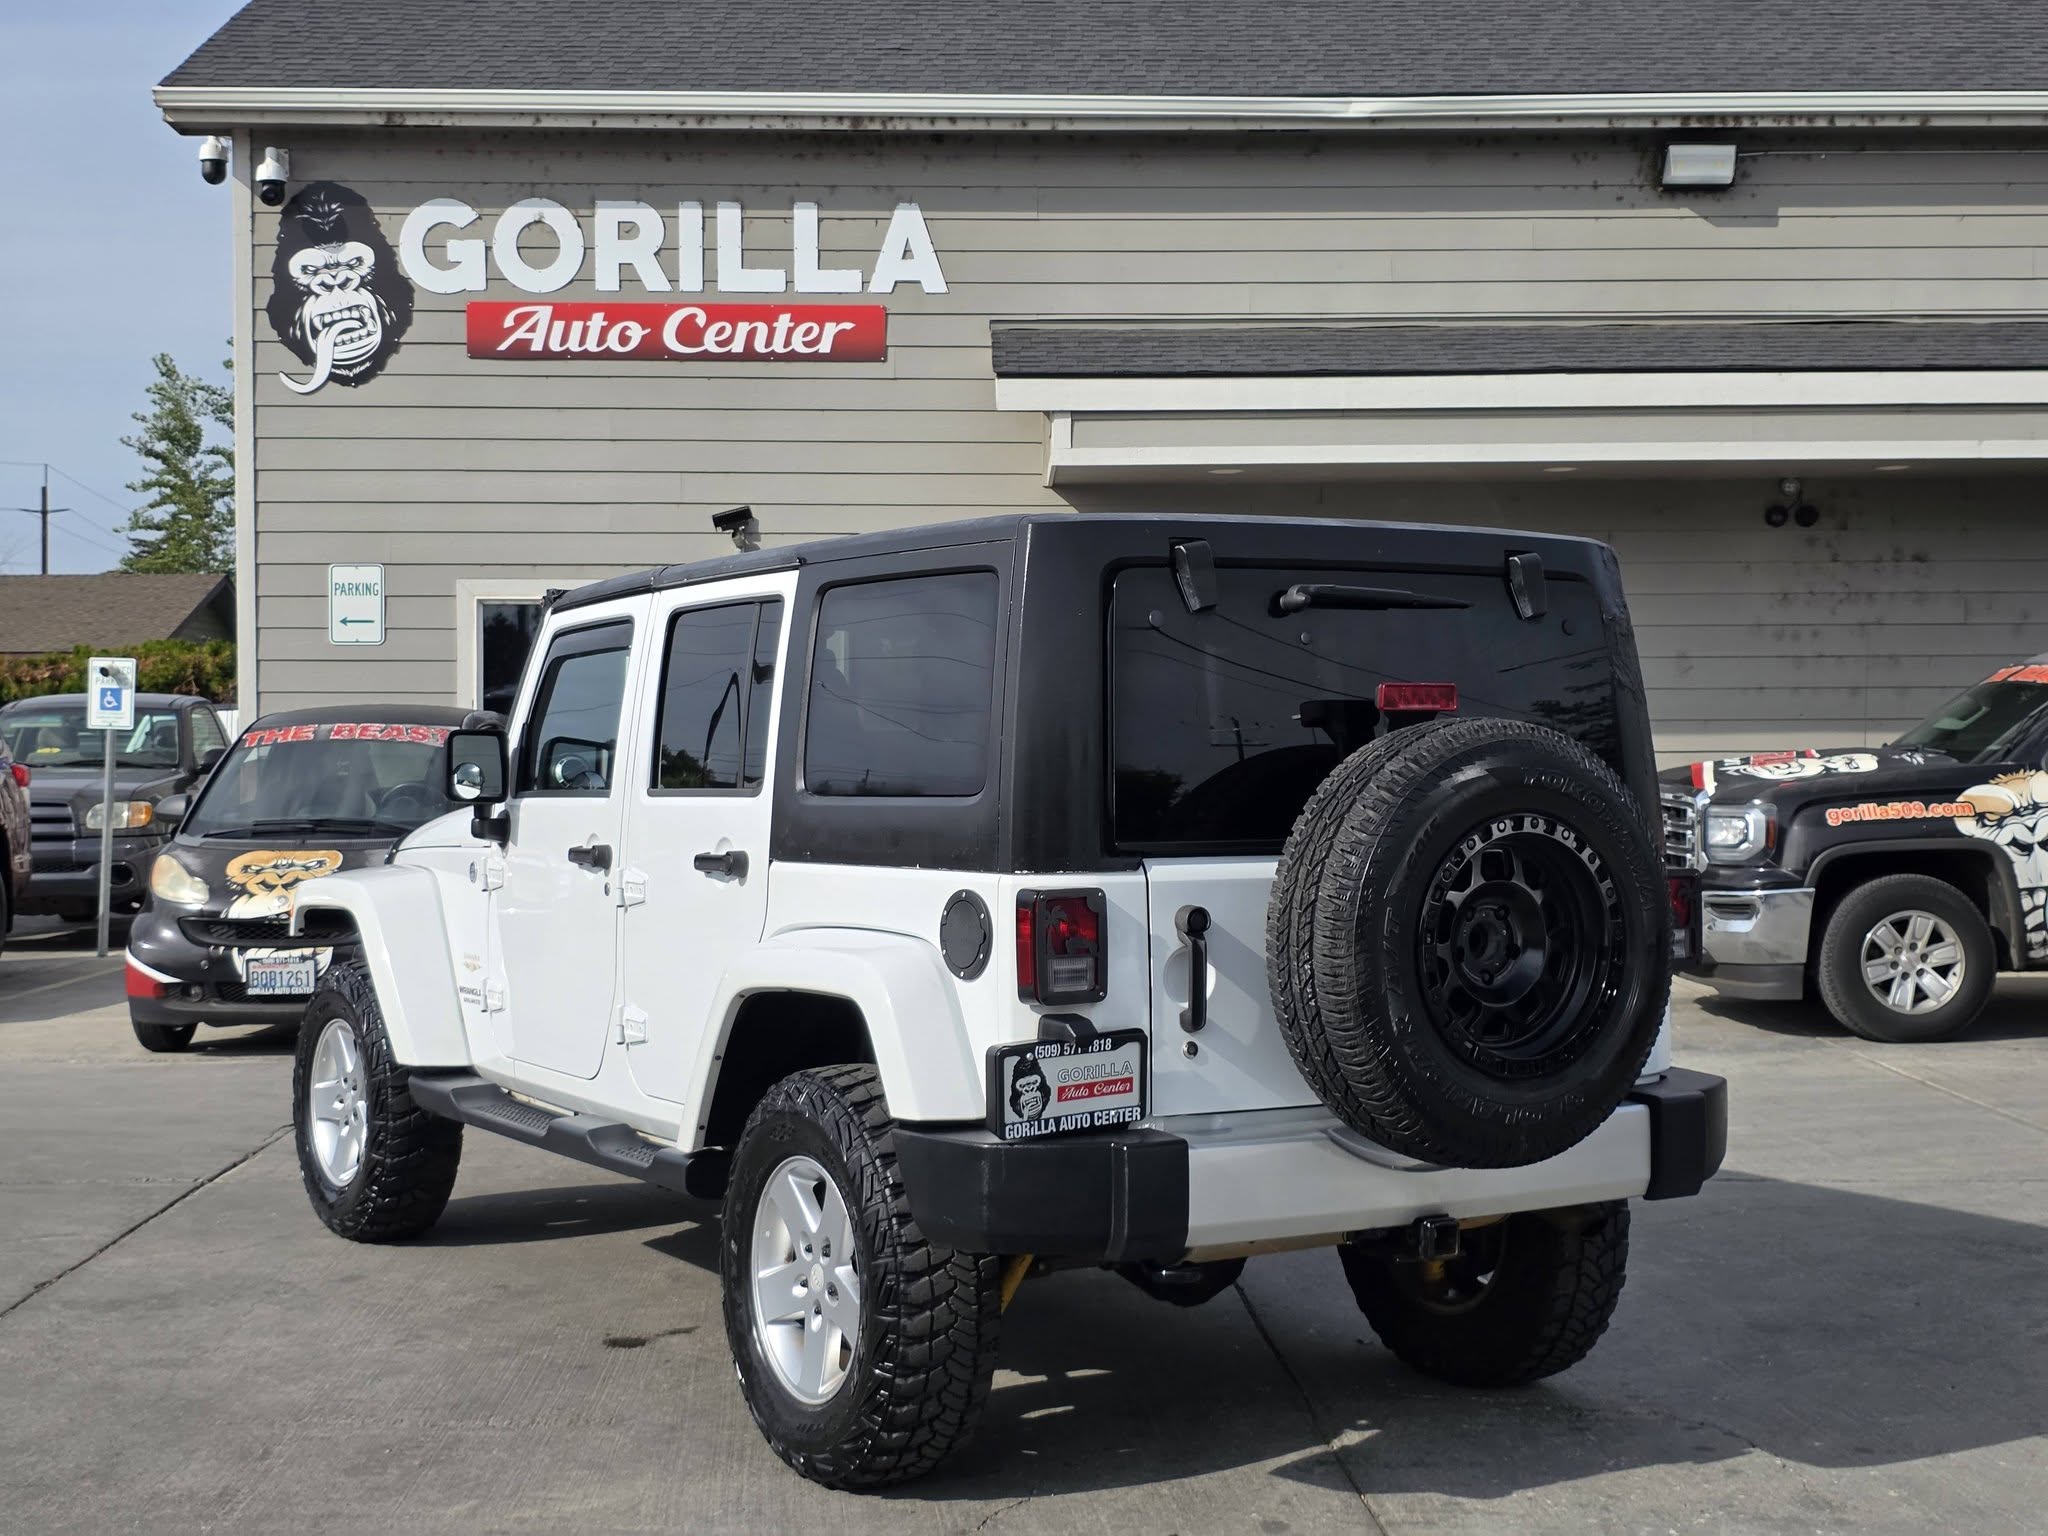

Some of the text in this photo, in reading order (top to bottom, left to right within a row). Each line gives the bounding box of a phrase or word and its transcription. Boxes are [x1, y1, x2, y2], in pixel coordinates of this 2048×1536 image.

[400, 197, 949, 294] GORILLA
[496, 305, 855, 354] Auto Center
[334, 582, 379, 597] PARKING
[243, 723, 449, 748] THE BEAST
[1826, 801, 1976, 827] gorilla509.com
[1034, 1043, 1061, 1059] (509)
[1057, 1061, 1133, 1084] GORILLA
[1062, 1082, 1132, 1100] Auto Center
[1059, 1113, 1091, 1132] AUTO
[1093, 1106, 1142, 1126] CENTER
